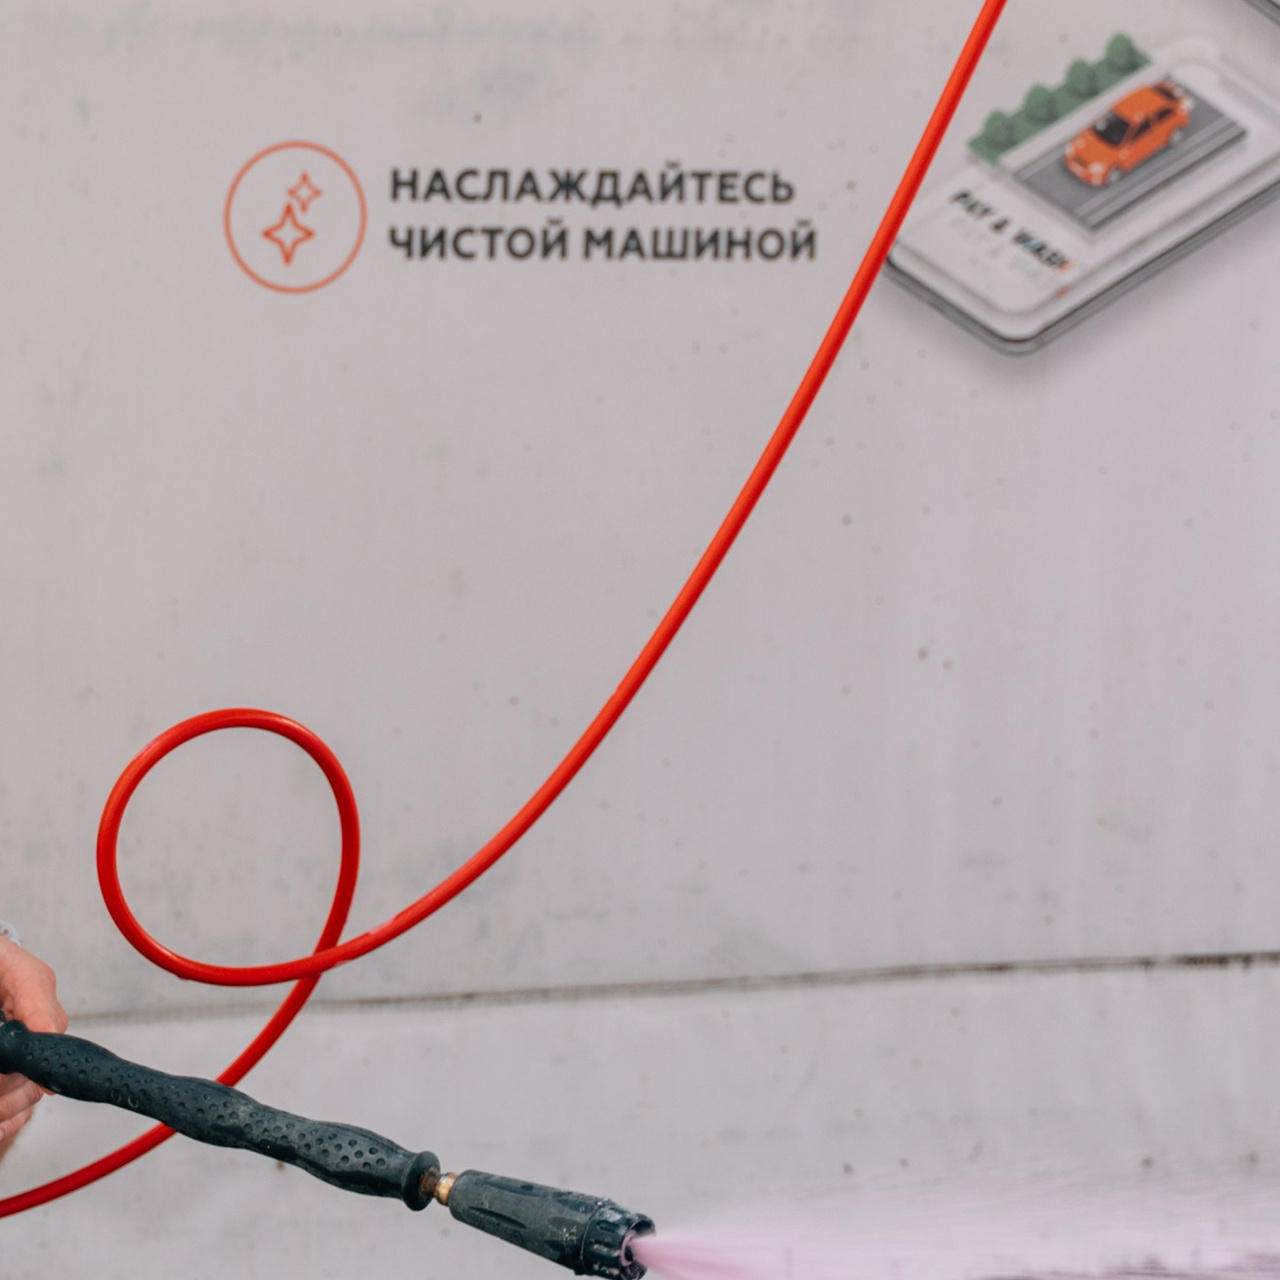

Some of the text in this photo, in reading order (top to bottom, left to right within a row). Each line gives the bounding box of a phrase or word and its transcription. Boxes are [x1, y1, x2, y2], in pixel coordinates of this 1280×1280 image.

[389, 160, 796, 207] НАСЛАЖДАЙТЕСЬ
[387, 216, 818, 261] ЧИСТОЙ МАШИНОЙ
